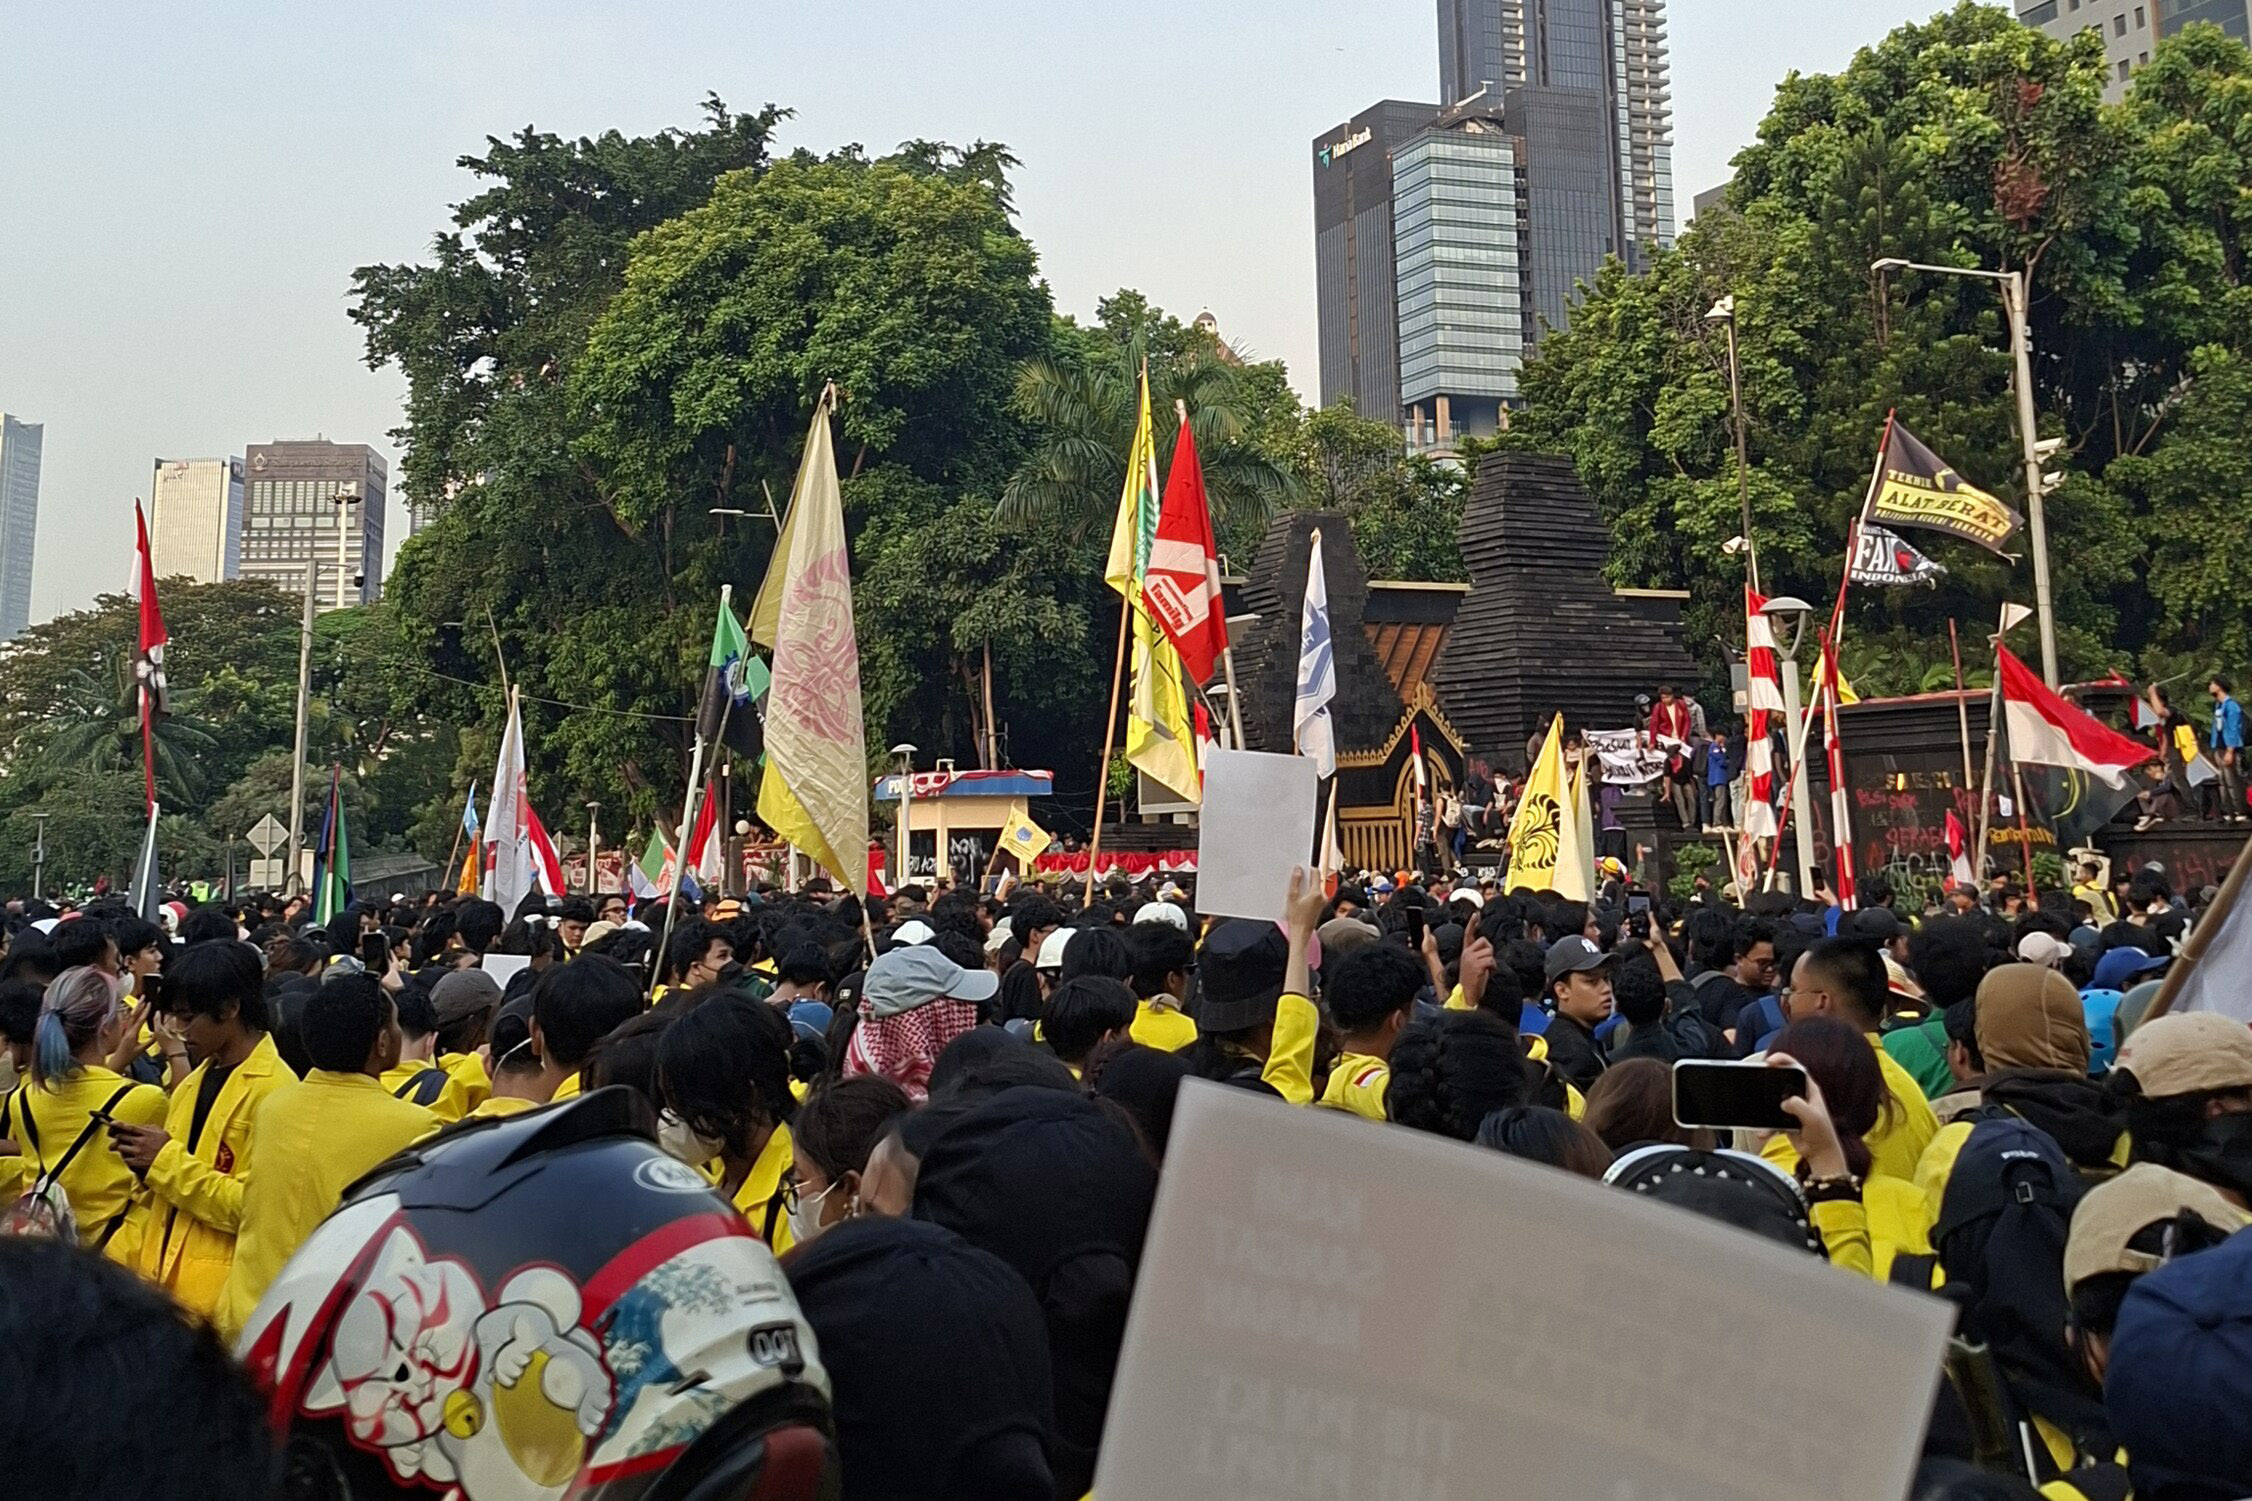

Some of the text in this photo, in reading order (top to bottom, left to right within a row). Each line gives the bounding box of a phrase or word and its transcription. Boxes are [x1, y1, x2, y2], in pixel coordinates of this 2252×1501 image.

[1332, 126, 1372, 159] Hana Bank
[1887, 469, 1932, 488] TEKNIK
[1885, 491, 2006, 531] ALAT BERAT
